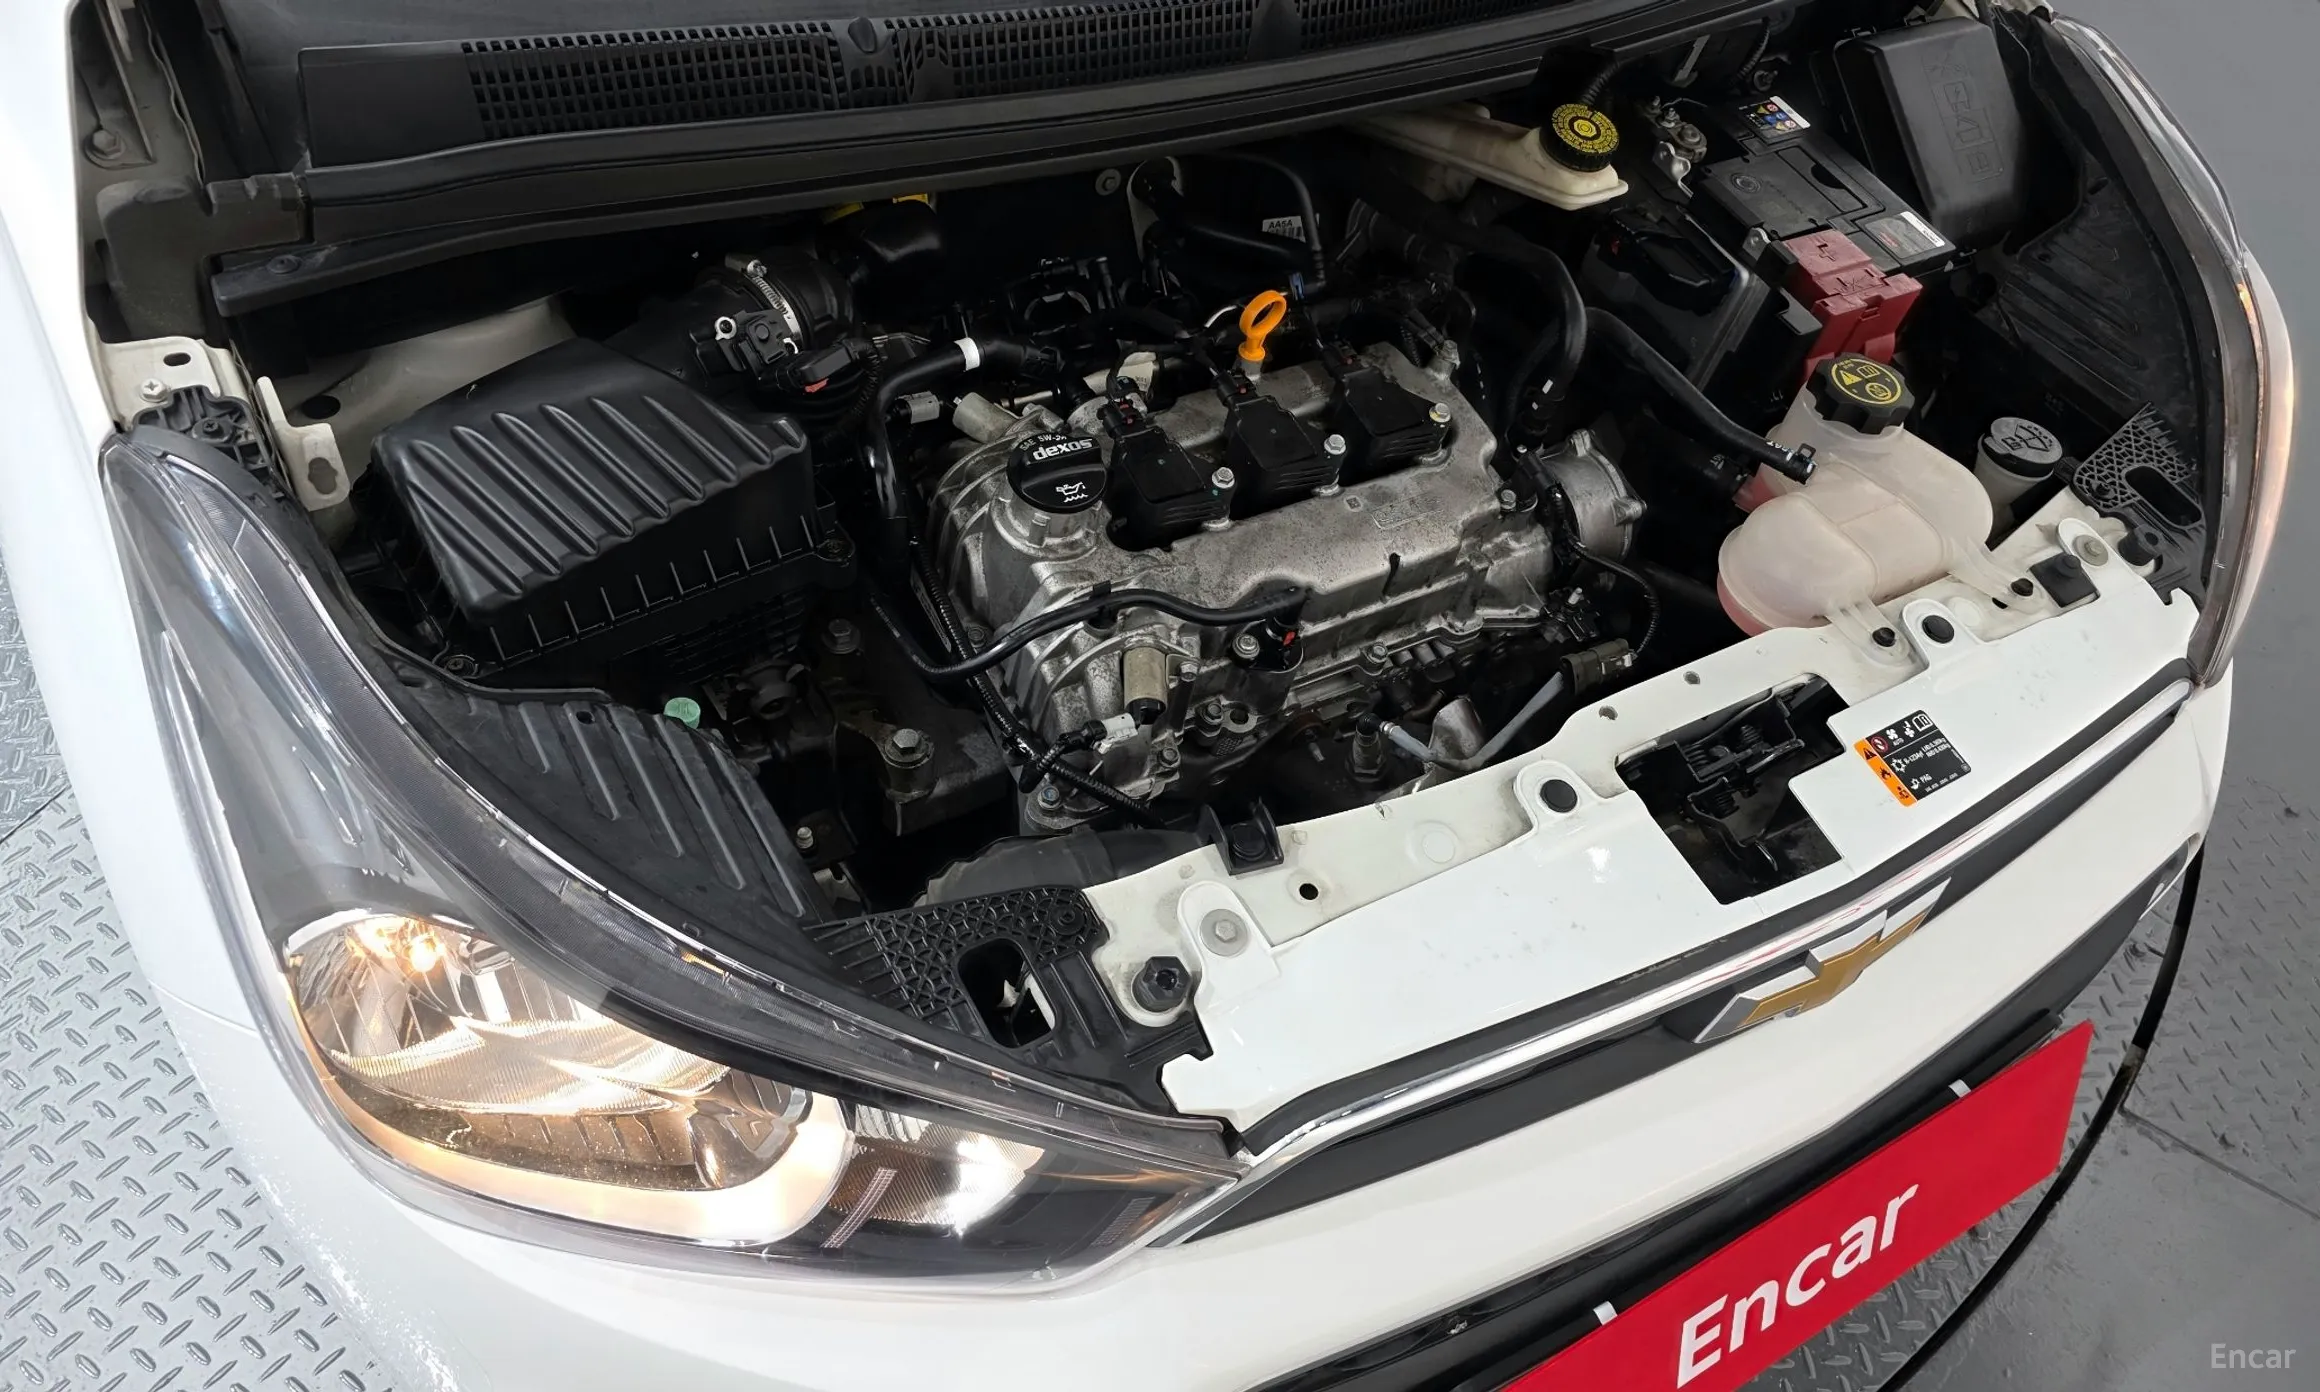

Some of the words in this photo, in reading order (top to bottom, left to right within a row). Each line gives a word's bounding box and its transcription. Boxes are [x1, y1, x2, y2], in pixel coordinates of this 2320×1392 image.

[1019, 438, 1036, 451] SAE
[1032, 438, 1093, 460] dexos
[1677, 1184, 1919, 1389] Encar
